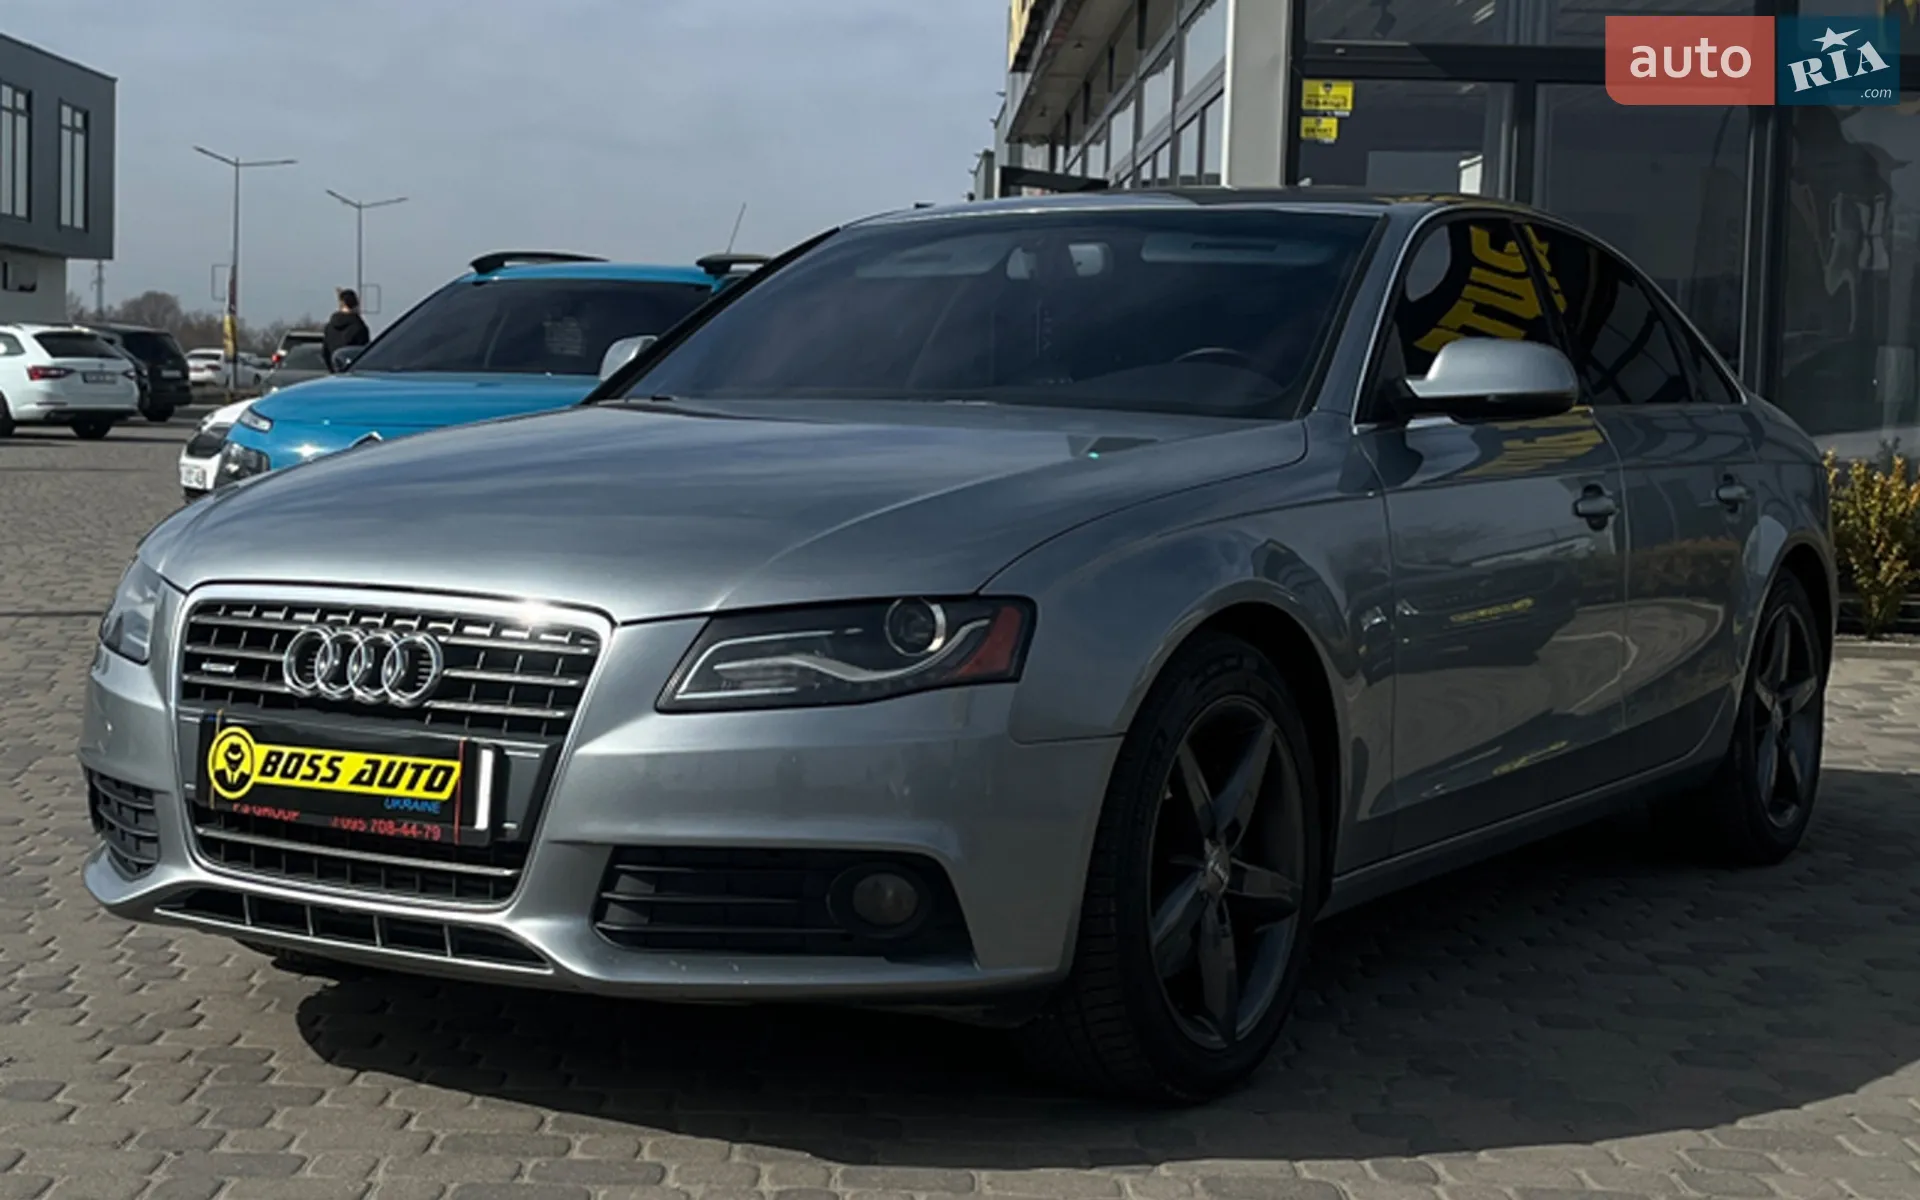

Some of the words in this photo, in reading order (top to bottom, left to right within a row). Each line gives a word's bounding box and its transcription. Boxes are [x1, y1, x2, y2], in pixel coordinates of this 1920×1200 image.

[259, 750, 344, 783] BOSS
[350, 759, 455, 793] AUTO
[383, 798, 441, 814] UKRAINE
